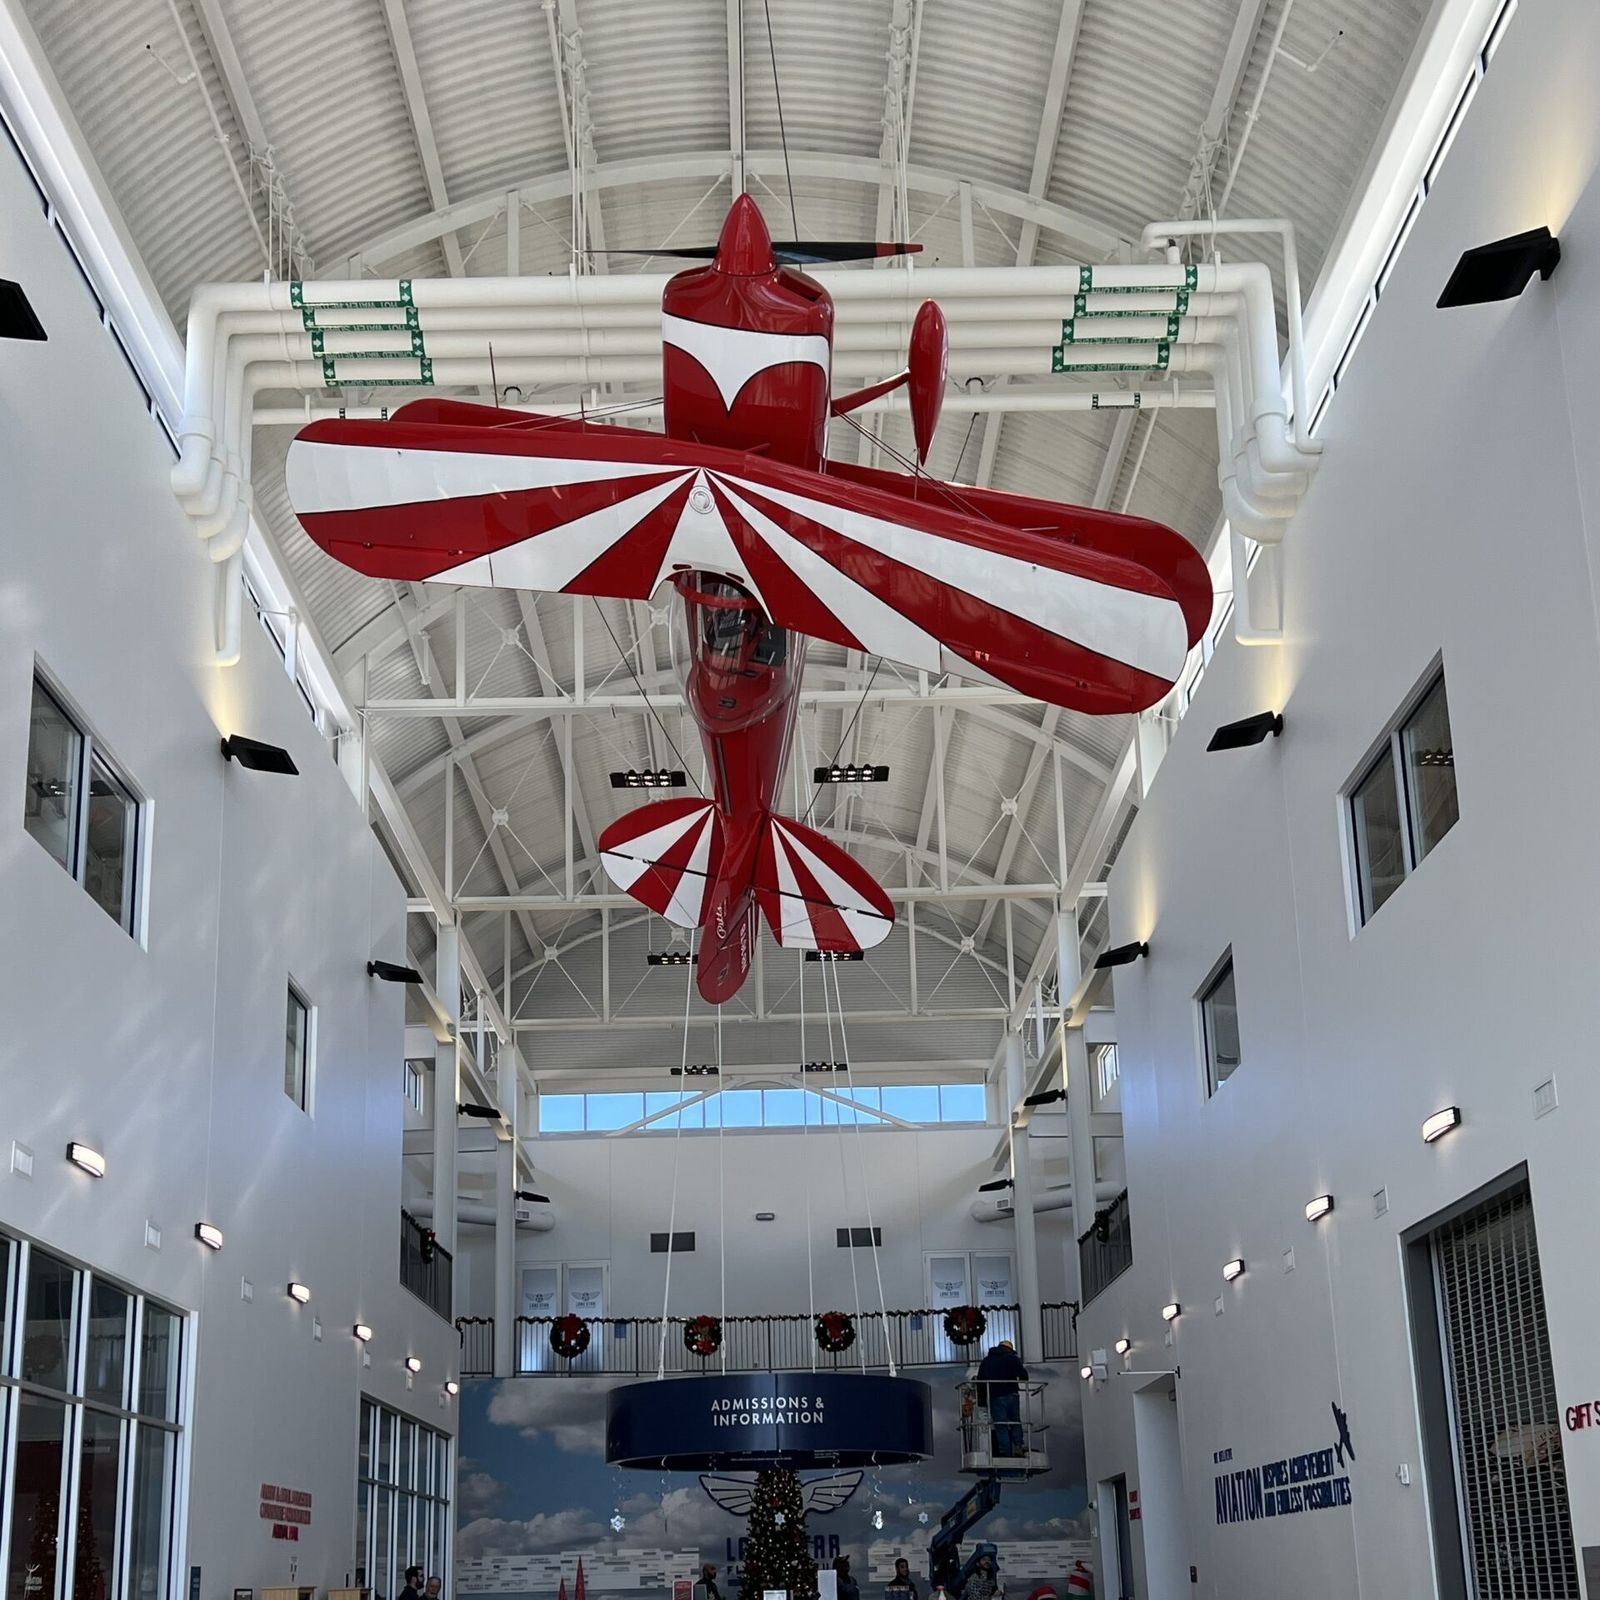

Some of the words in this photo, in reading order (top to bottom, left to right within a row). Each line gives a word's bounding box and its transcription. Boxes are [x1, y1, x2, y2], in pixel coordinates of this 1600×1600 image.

[716, 905, 726, 939] Pitts
[711, 1396, 808, 1411] ADMISSIONS
[815, 1396, 824, 1409] &
[713, 1411, 824, 1427] INFORMATION
[1565, 1402, 1592, 1432] GIFT
[1289, 1447, 1334, 1483] ACHIEVEMENT
[1214, 1466, 1264, 1525] AVIATION
[1276, 1486, 1303, 1515] ENDLESS
[1303, 1475, 1352, 1511] POSSIBILITIES
